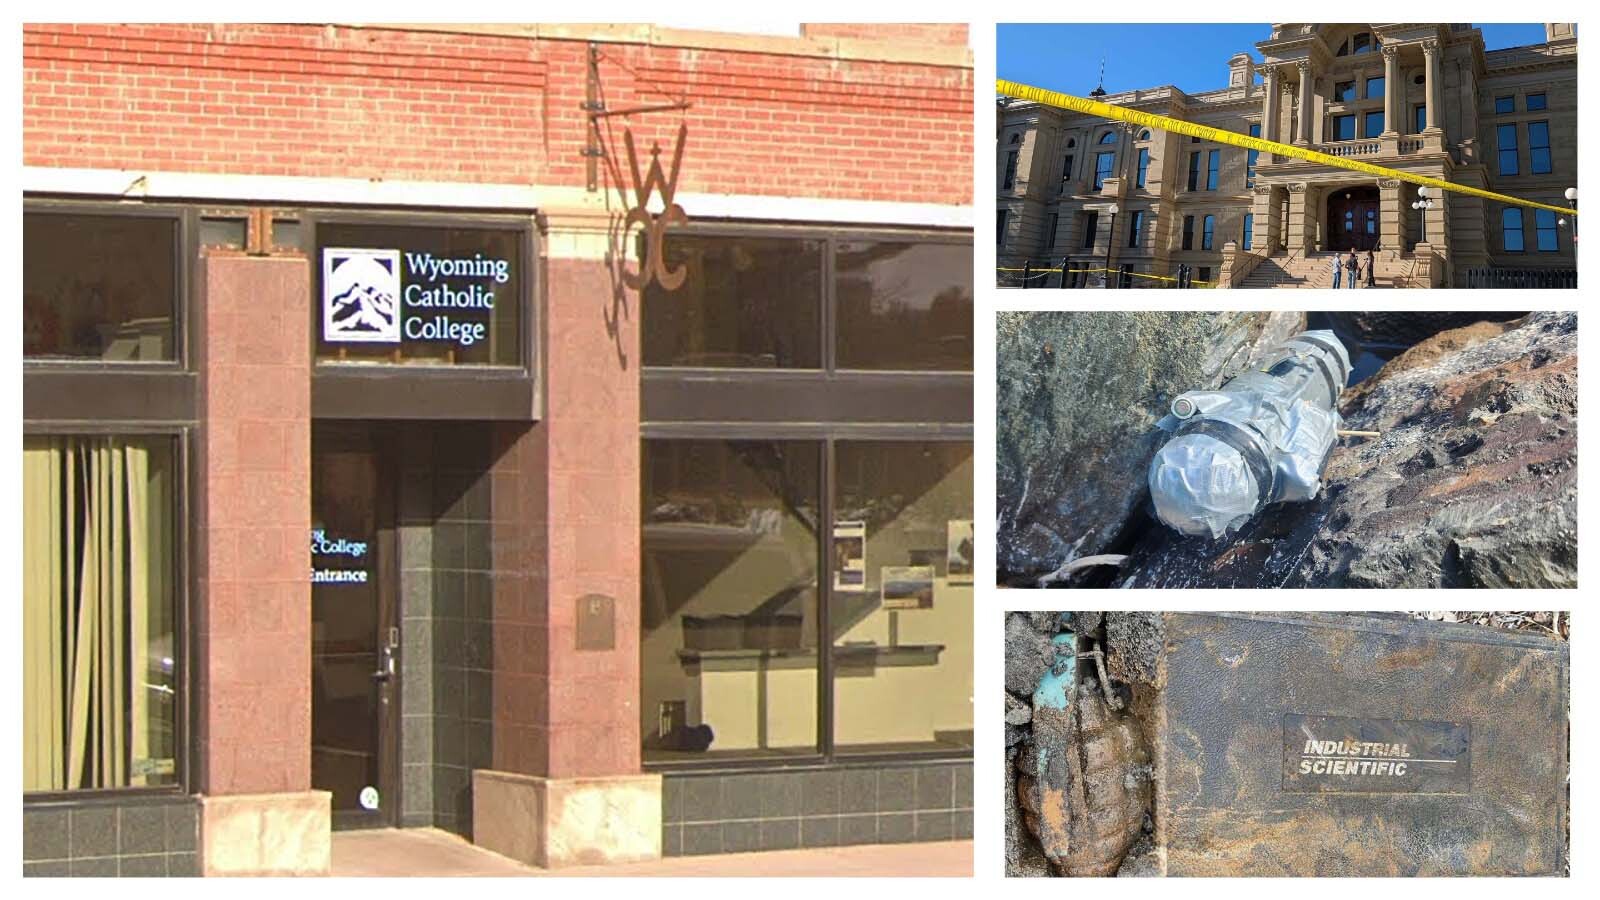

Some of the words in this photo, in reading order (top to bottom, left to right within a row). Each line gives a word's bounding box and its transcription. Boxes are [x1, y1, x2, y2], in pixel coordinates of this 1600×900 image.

[405, 253, 508, 283] Wyoming
[404, 284, 495, 308] Catholic
[404, 316, 485, 345] College
[320, 539, 366, 556] College
[1303, 740, 1410, 758] INDUSTRIAL
[1298, 760, 1407, 777] SCIENTIFIC
